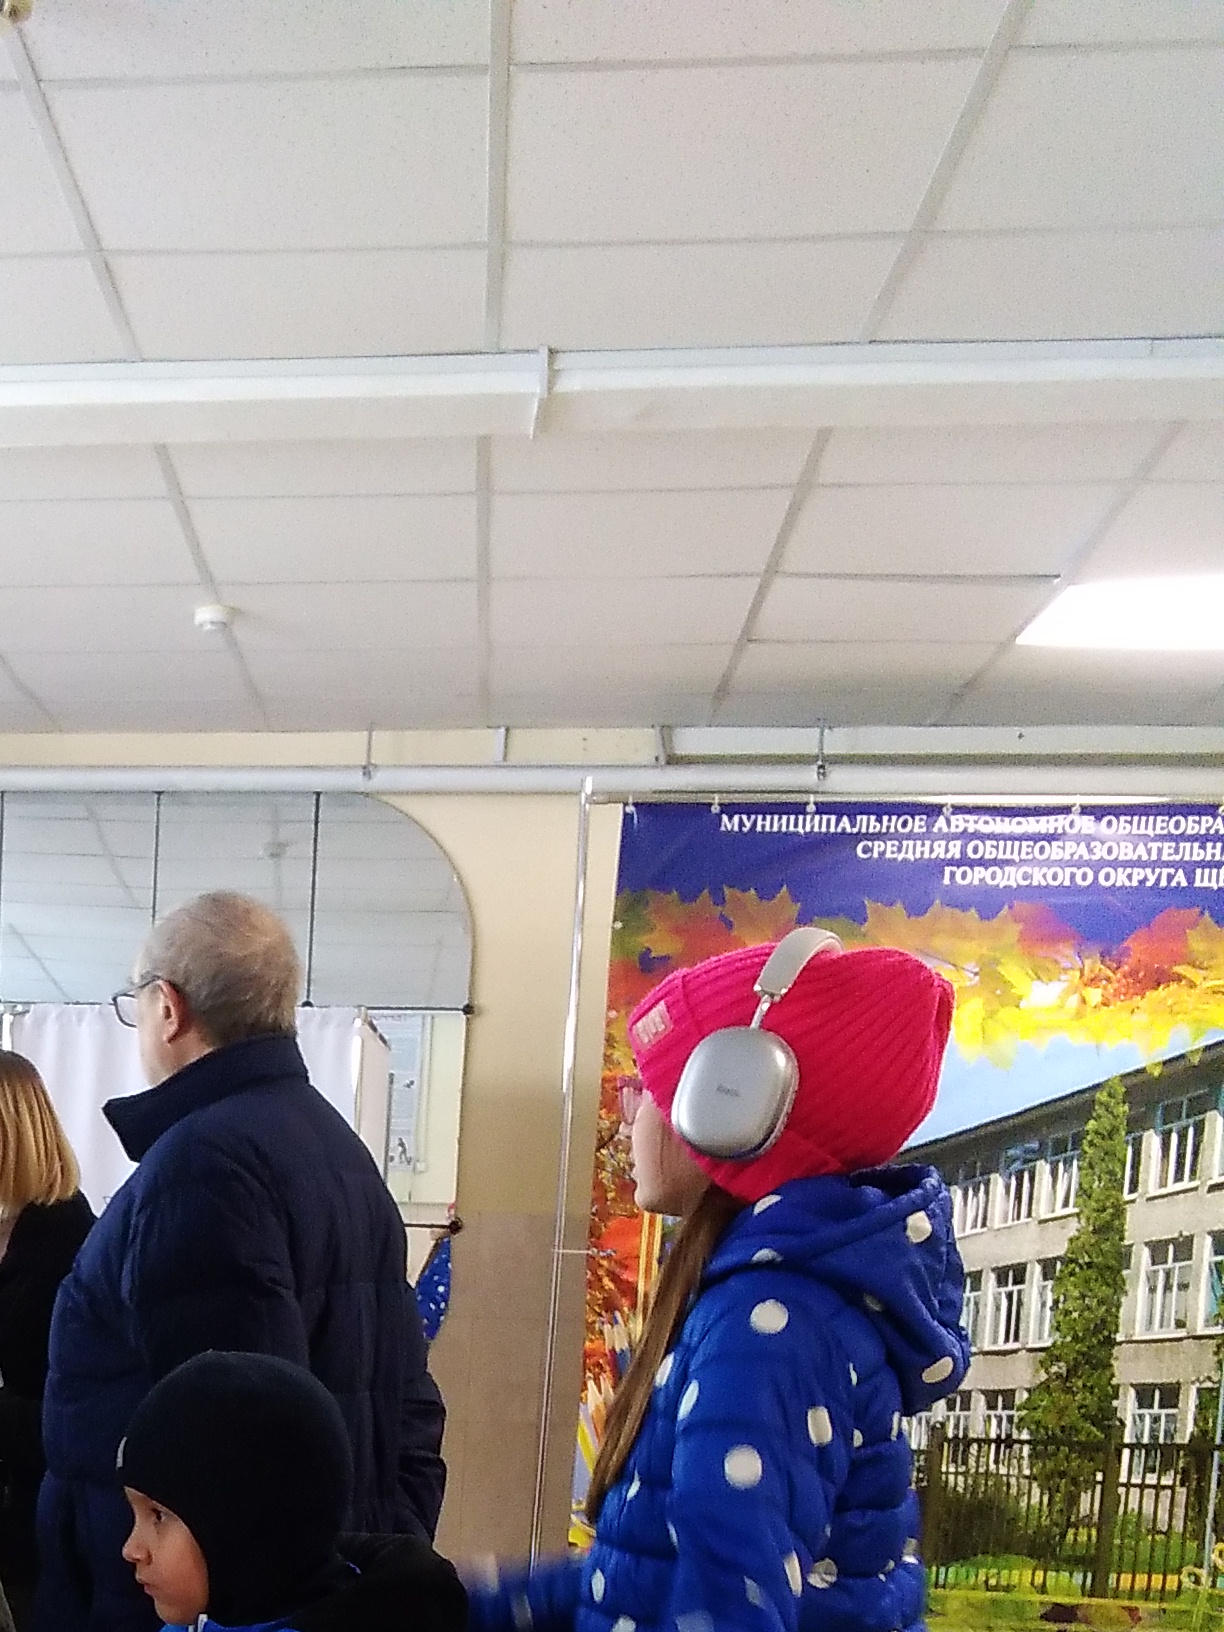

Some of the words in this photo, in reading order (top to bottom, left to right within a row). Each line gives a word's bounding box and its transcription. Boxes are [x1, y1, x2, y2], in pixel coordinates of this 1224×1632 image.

[719, 814, 927, 836] МУНИЦИПАЛЬНОЕ
[933, 815, 1095, 834] АВТОНОМНОЕ
[1101, 815, 1224, 837] ОБЩЕОБРА
[856, 840, 961, 861] СРЕДНЯЯ
[967, 841, 1224, 862] ОБЩЕОБРАЗОВАТЕЛЬН
[943, 866, 1094, 888] ГОРОДСКОГО
[1098, 867, 1188, 887] ОКРУГА
